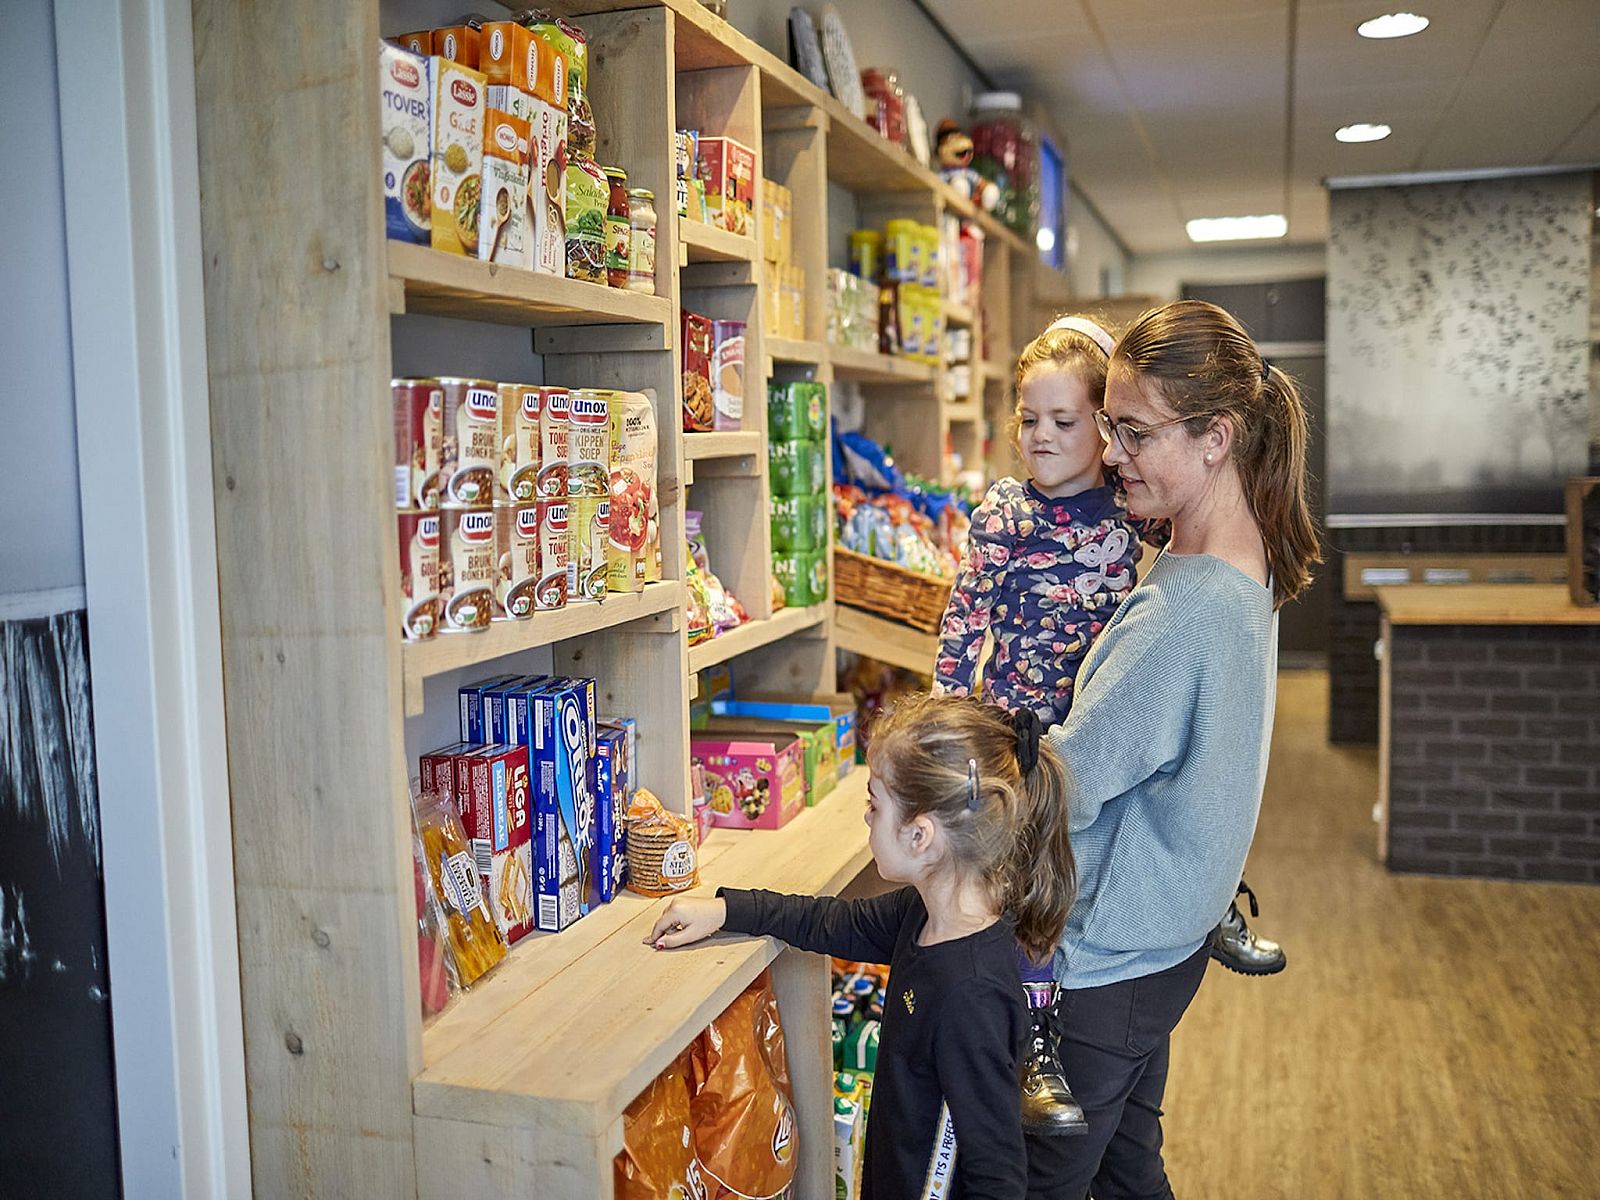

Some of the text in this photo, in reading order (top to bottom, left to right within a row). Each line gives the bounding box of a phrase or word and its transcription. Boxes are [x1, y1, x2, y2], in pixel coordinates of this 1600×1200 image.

[575, 435, 604, 448] KIPPEN
[580, 448, 601, 460] SOEP
[565, 705, 588, 831] OREO
[495, 768, 505, 843] MILKBREAK
[514, 764, 526, 829] LIGA
[940, 1152, 950, 1160] A
